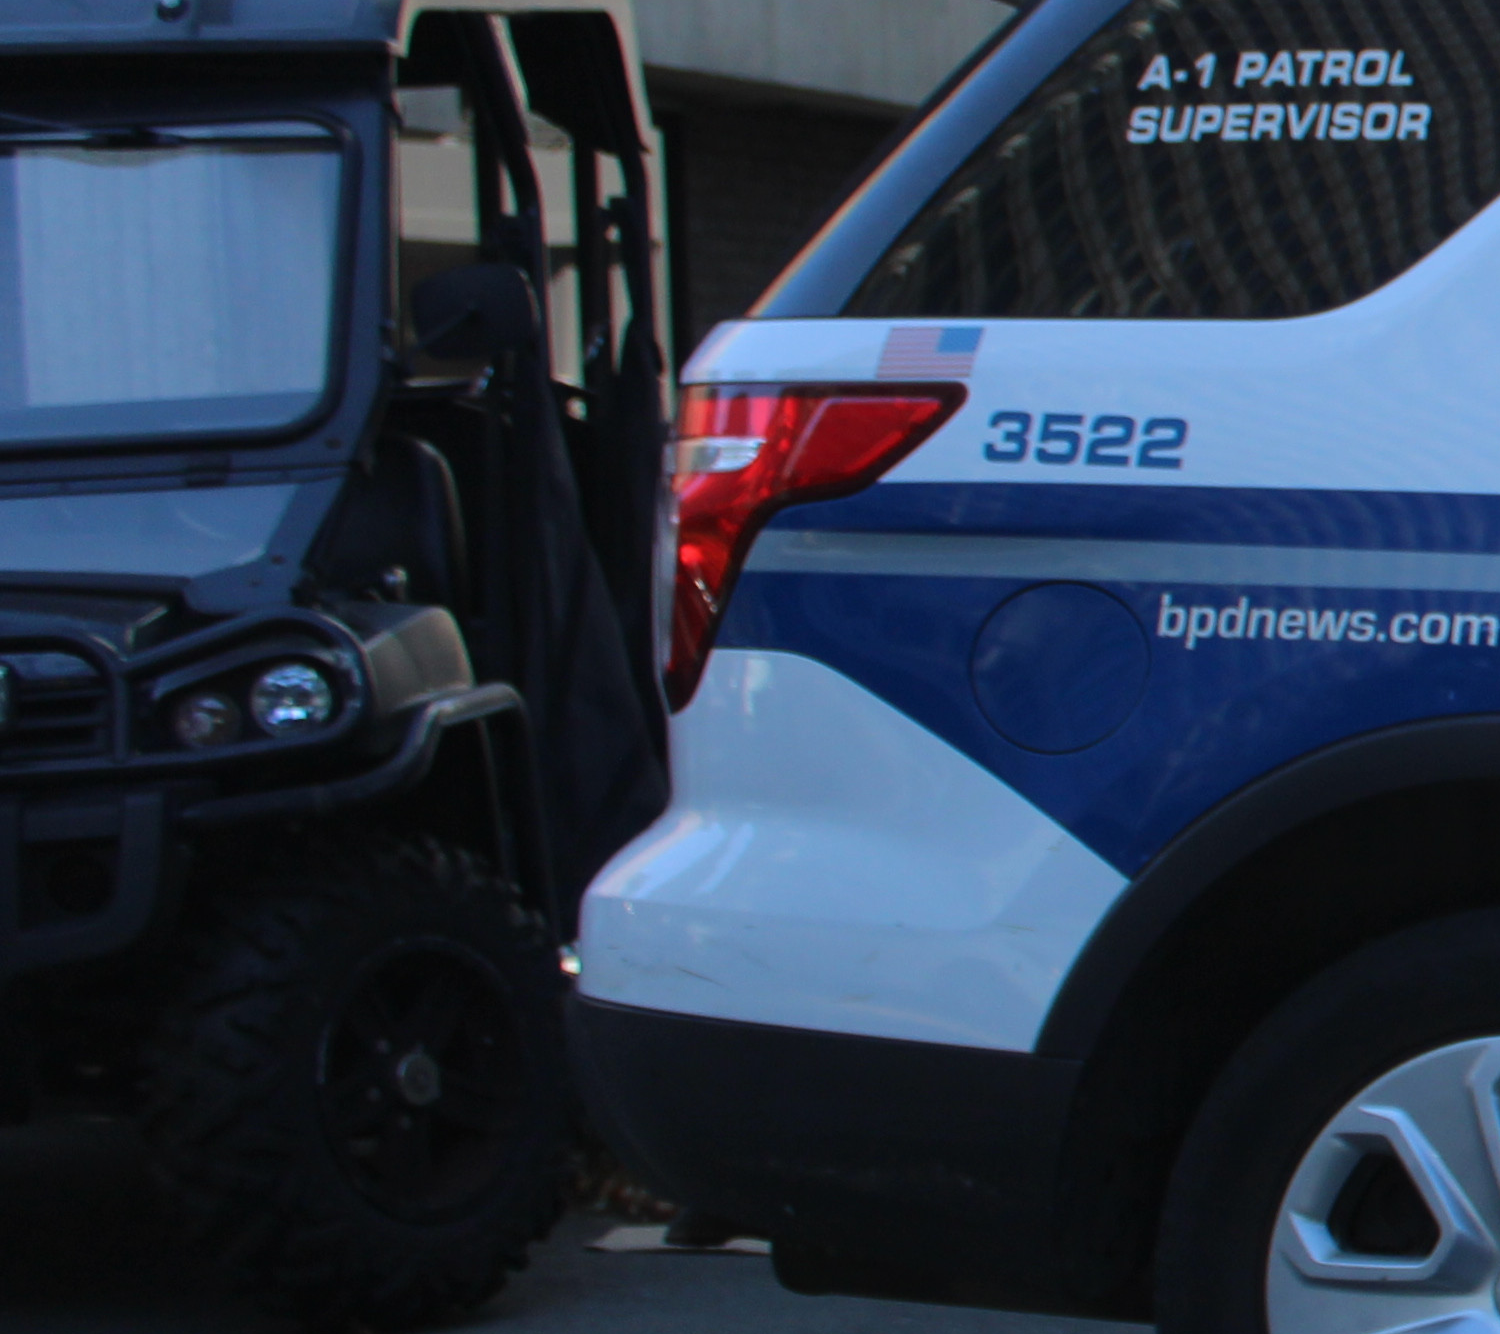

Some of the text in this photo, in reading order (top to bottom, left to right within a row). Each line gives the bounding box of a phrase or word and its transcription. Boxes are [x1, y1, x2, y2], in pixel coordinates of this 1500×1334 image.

[1137, 49, 1414, 91] A-1 PATROL
[1126, 102, 1432, 144] SUPERVISOR
[983, 410, 1188, 470] 3522
[1156, 593, 1500, 650] bpdnews.com
